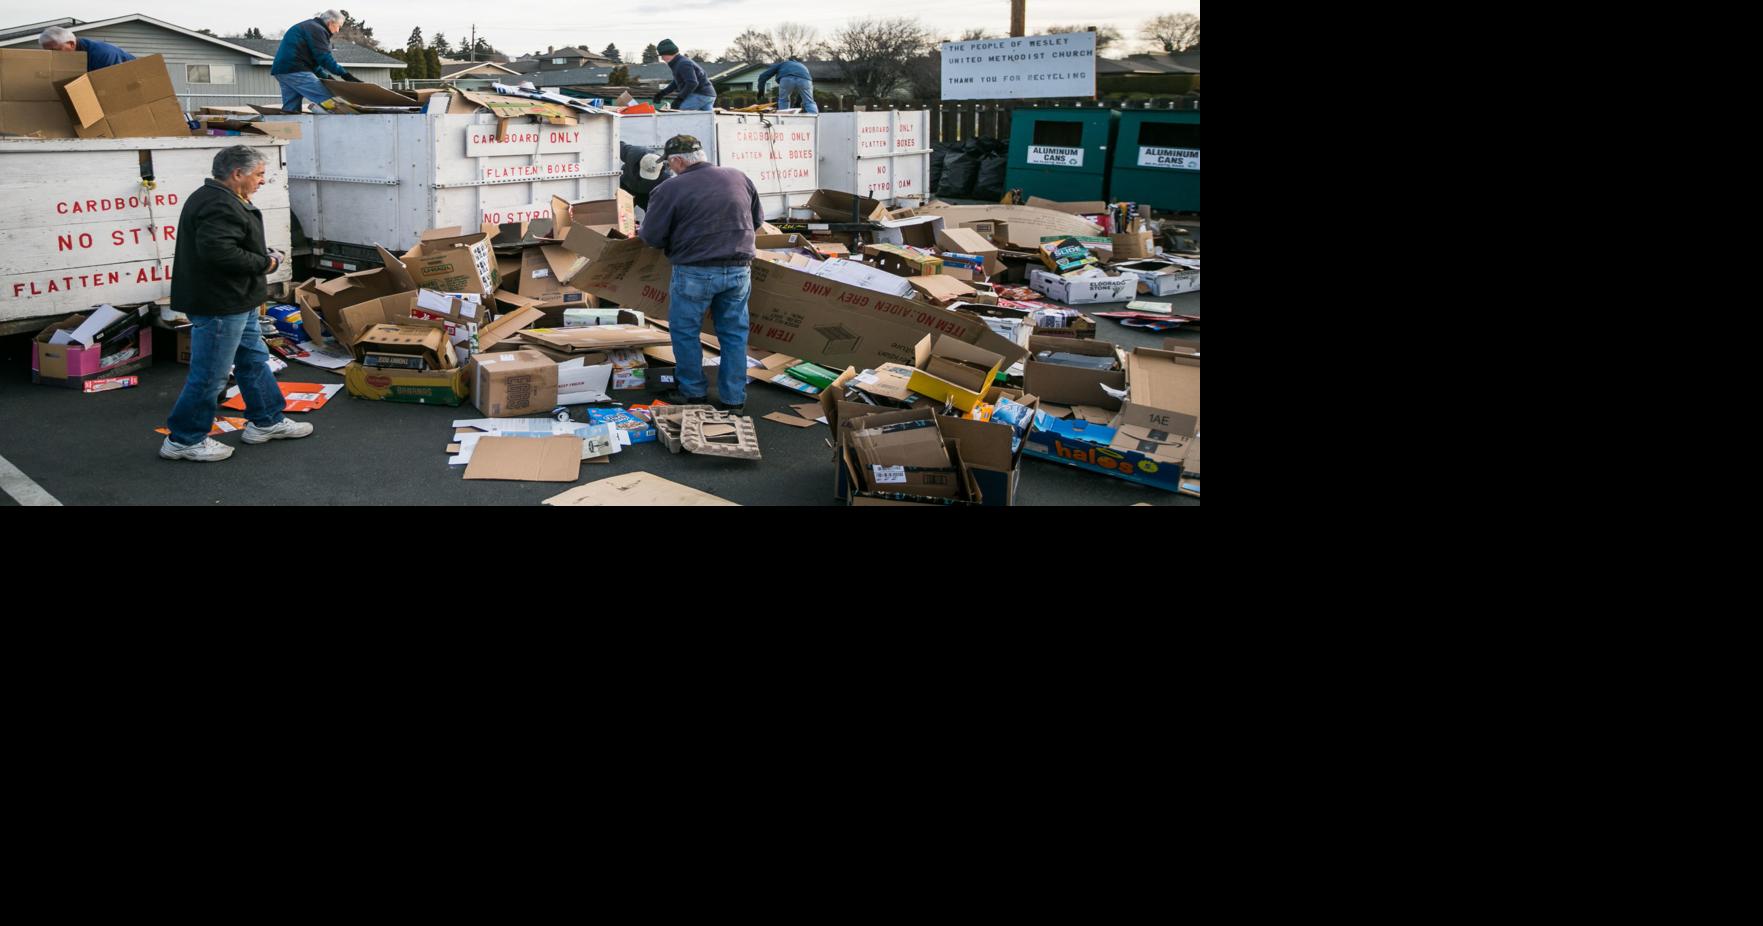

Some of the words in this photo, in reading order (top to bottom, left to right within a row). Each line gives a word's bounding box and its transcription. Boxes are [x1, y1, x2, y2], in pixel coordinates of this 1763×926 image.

[971, 42, 1005, 51] PEOPLE
[1011, 40, 1022, 48] OF
[1029, 38, 1069, 47] WESLEY
[949, 56, 982, 64] UNITED
[988, 53, 1045, 62] METHODIST
[1052, 50, 1093, 58] CHURCH
[1003, 74, 1021, 82] FOR
[1027, 72, 1086, 81] RECYCLING
[899, 124, 914, 132] ONLY
[550, 132, 580, 143] ONLY
[791, 131, 811, 141] ONLY
[861, 140, 887, 148] FLATTEN
[896, 138, 915, 147] BOXES
[731, 151, 763, 160] FLATTEN
[769, 151, 783, 160] ALL
[789, 150, 813, 160] BOXES
[1033, 147, 1078, 156] ALUMINUM
[1145, 148, 1199, 158] ALUMINUM
[1044, 154, 1066, 162] CANS
[1157, 156, 1184, 164] CANS
[487, 166, 538, 178] FLATTEN
[547, 163, 580, 174] BOXES
[760, 169, 809, 180] STYROFOAM
[877, 166, 886, 175] NO
[484, 212, 500, 224] NO
[58, 233, 93, 251] NO
[14, 272, 119, 297] FLATTEN
[136, 265, 172, 284] ALL
[641, 285, 667, 304] KING
[802, 281, 831, 297] KING
[837, 291, 870, 307] GREY
[937, 317, 966, 338] ITEM
[767, 328, 795, 343] ITEM
[1055, 440, 1134, 474] halos
